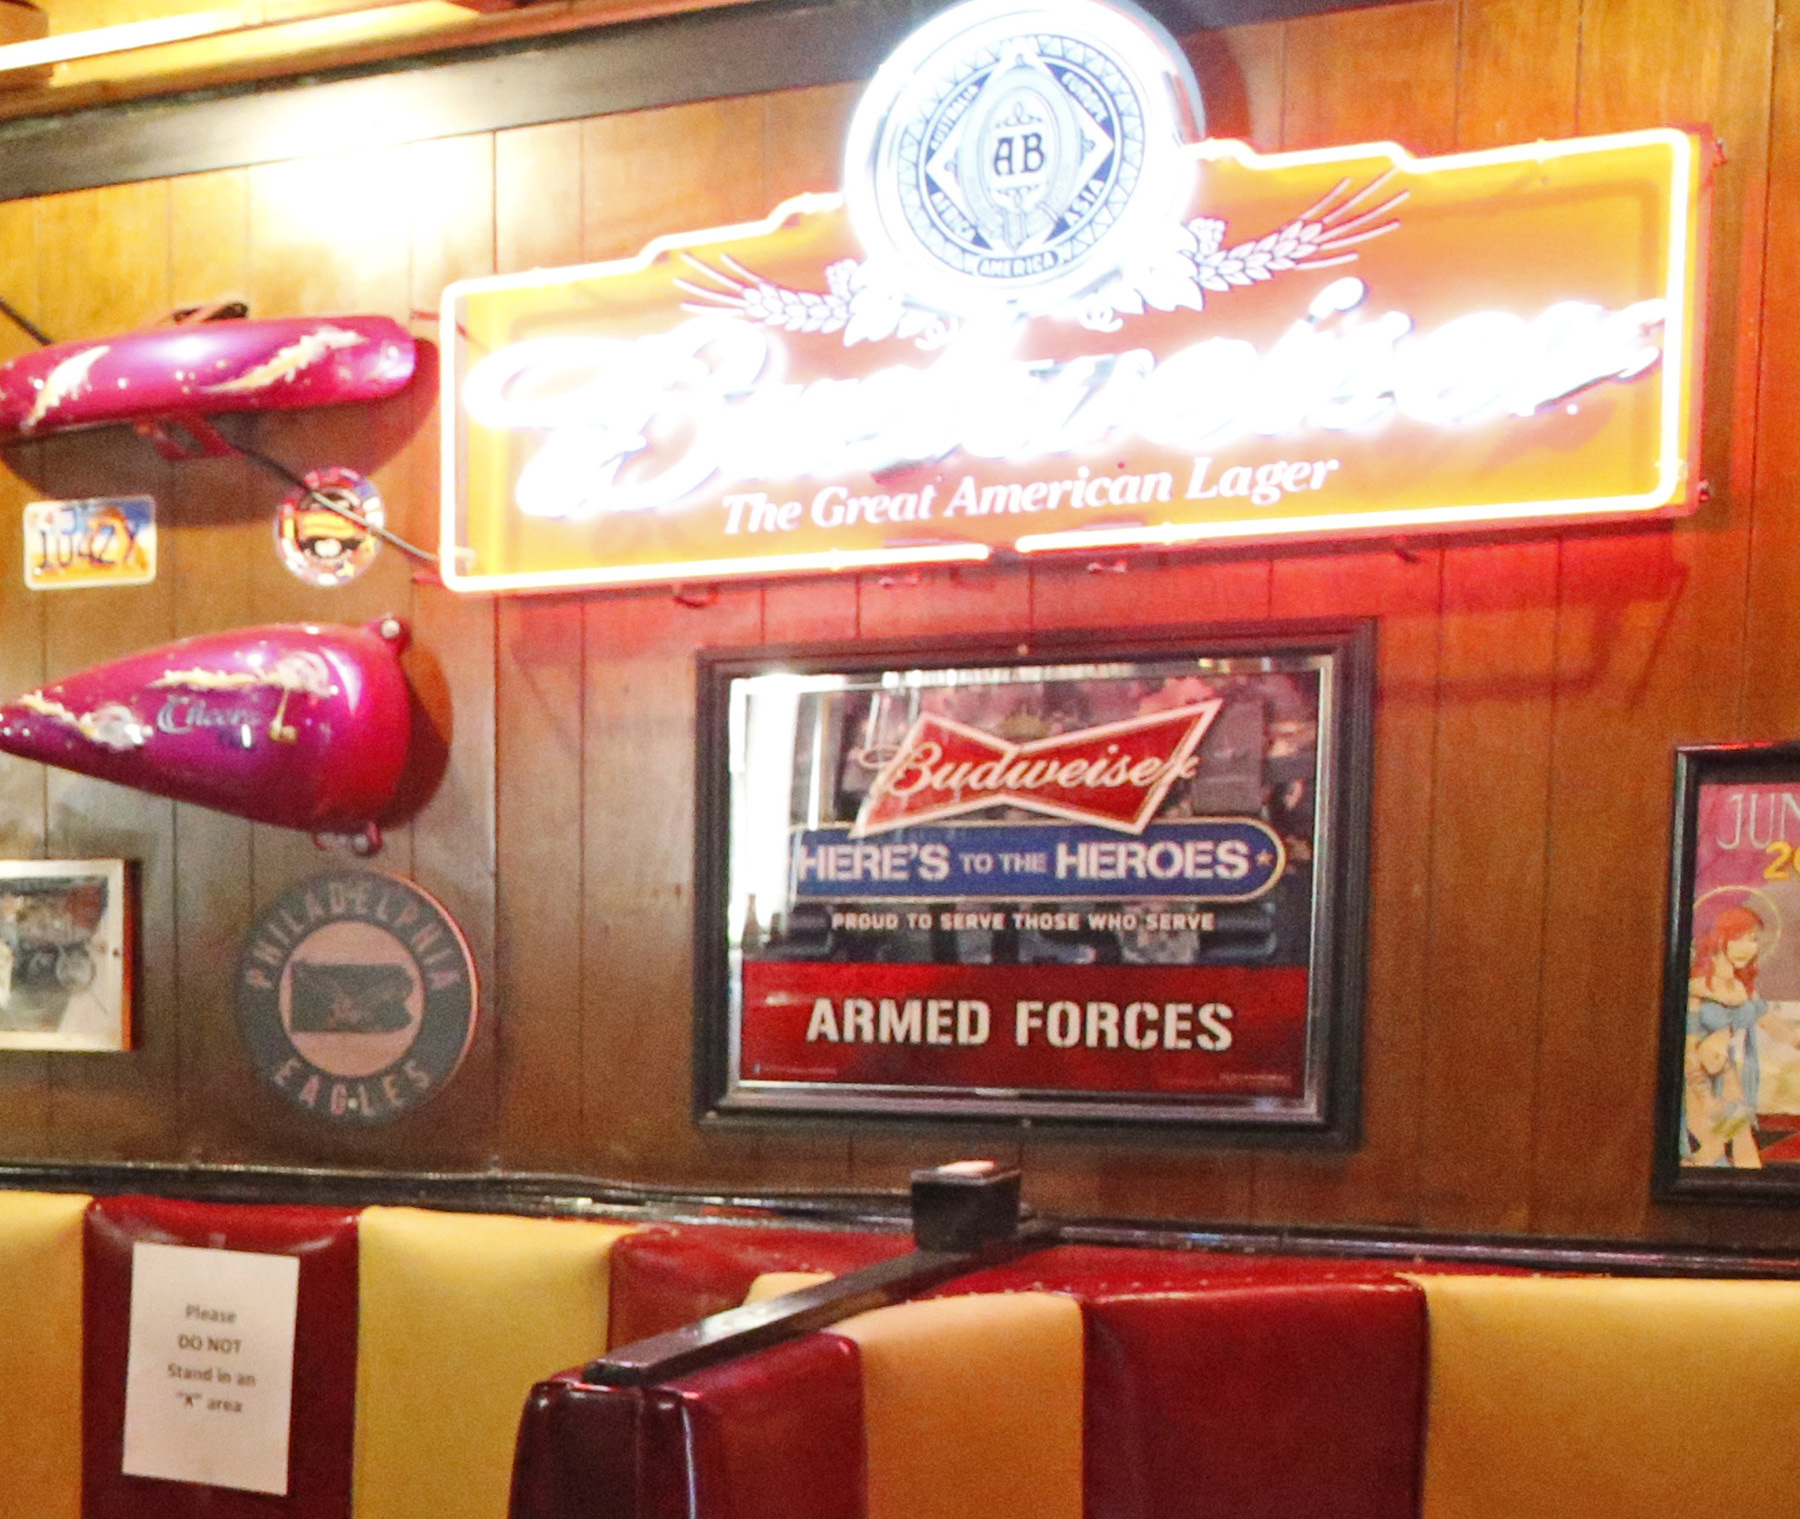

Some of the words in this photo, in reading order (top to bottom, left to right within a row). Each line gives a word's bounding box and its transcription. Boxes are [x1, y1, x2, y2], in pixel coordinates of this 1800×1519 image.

[992, 131, 1046, 178] AB
[980, 250, 1058, 277] AMERICA
[722, 491, 800, 535] The
[811, 483, 936, 528] Great
[941, 464, 1173, 519] American
[1184, 455, 1341, 507] Lager
[860, 740, 1200, 798] Budweiser
[799, 842, 951, 882] HERE'S
[959, 851, 994, 874] TO
[999, 851, 1048, 874] THE
[1056, 839, 1250, 881] HEROES
[1763, 840, 1800, 882] 2
[244, 881, 461, 990] PHILADELPHIA
[831, 913, 899, 931] PROUD
[907, 913, 933, 931] TO
[940, 913, 1006, 931] SERVE
[1012, 913, 1080, 931] THOSE
[1088, 913, 1135, 931] WHO
[1144, 913, 1216, 931] SERVE
[806, 997, 992, 1045] ARMED
[1015, 999, 1235, 1052] FORCES
[272, 1057, 431, 1118] EAGLES
[185, 1304, 237, 1323] Please
[178, 1334, 202, 1352] DO
[207, 1337, 242, 1354] NOT
[167, 1362, 213, 1383] Stand
[217, 1365, 232, 1384] in
[236, 1371, 256, 1387] an
[206, 1397, 243, 1414] area
